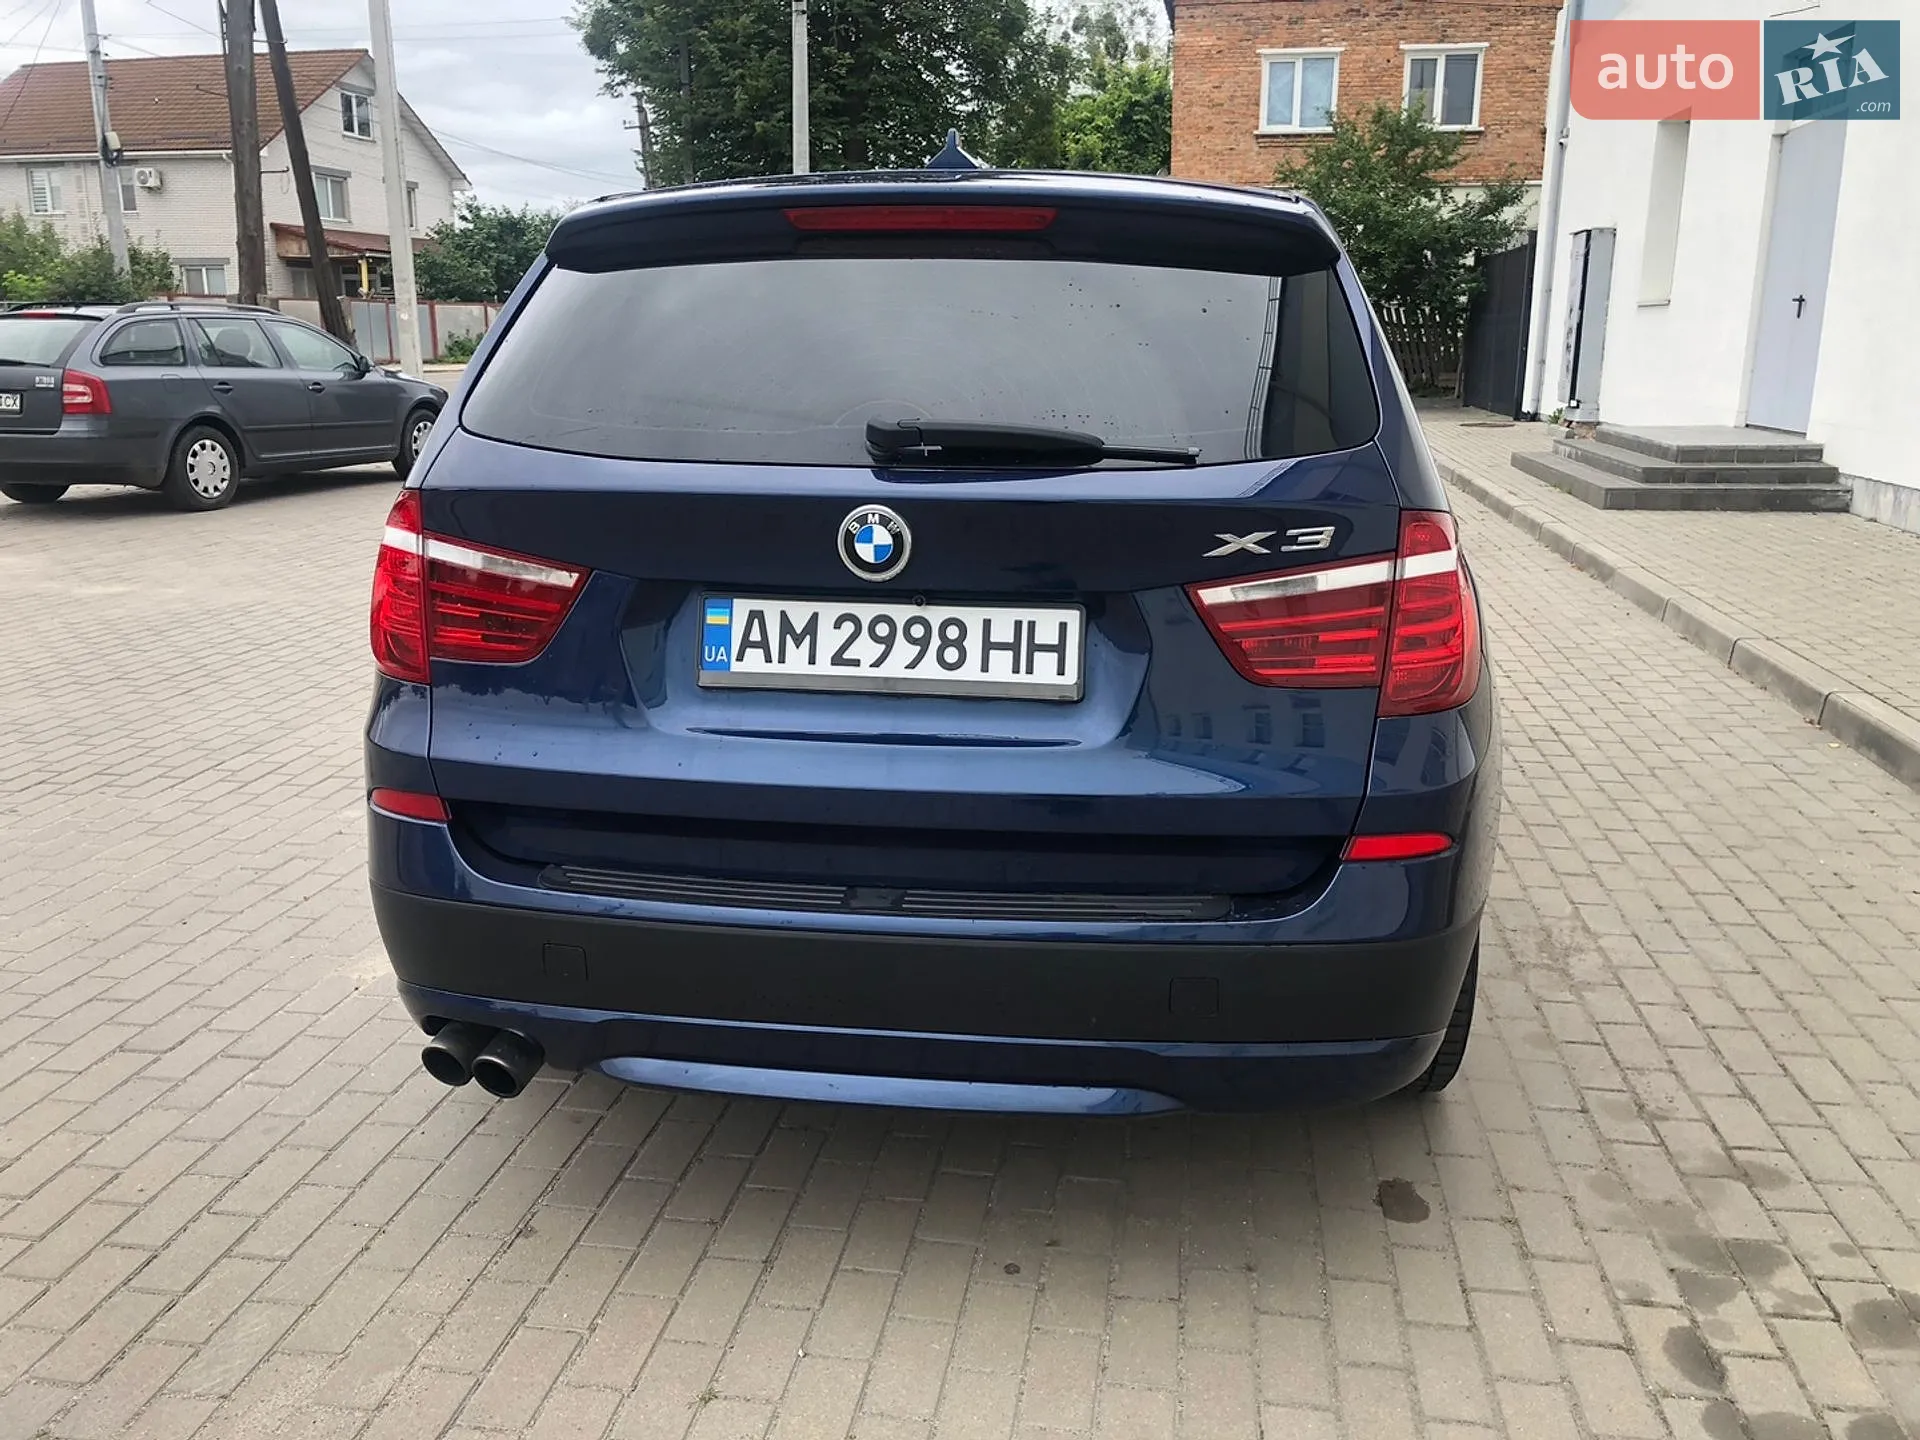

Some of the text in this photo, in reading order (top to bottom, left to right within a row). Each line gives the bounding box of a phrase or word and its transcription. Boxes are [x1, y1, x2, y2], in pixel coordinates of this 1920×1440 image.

[848, 513, 900, 534] BMW
[1201, 526, 1335, 557] X3
[704, 645, 728, 663] UA
[735, 609, 1068, 676] AM 2998 HH
